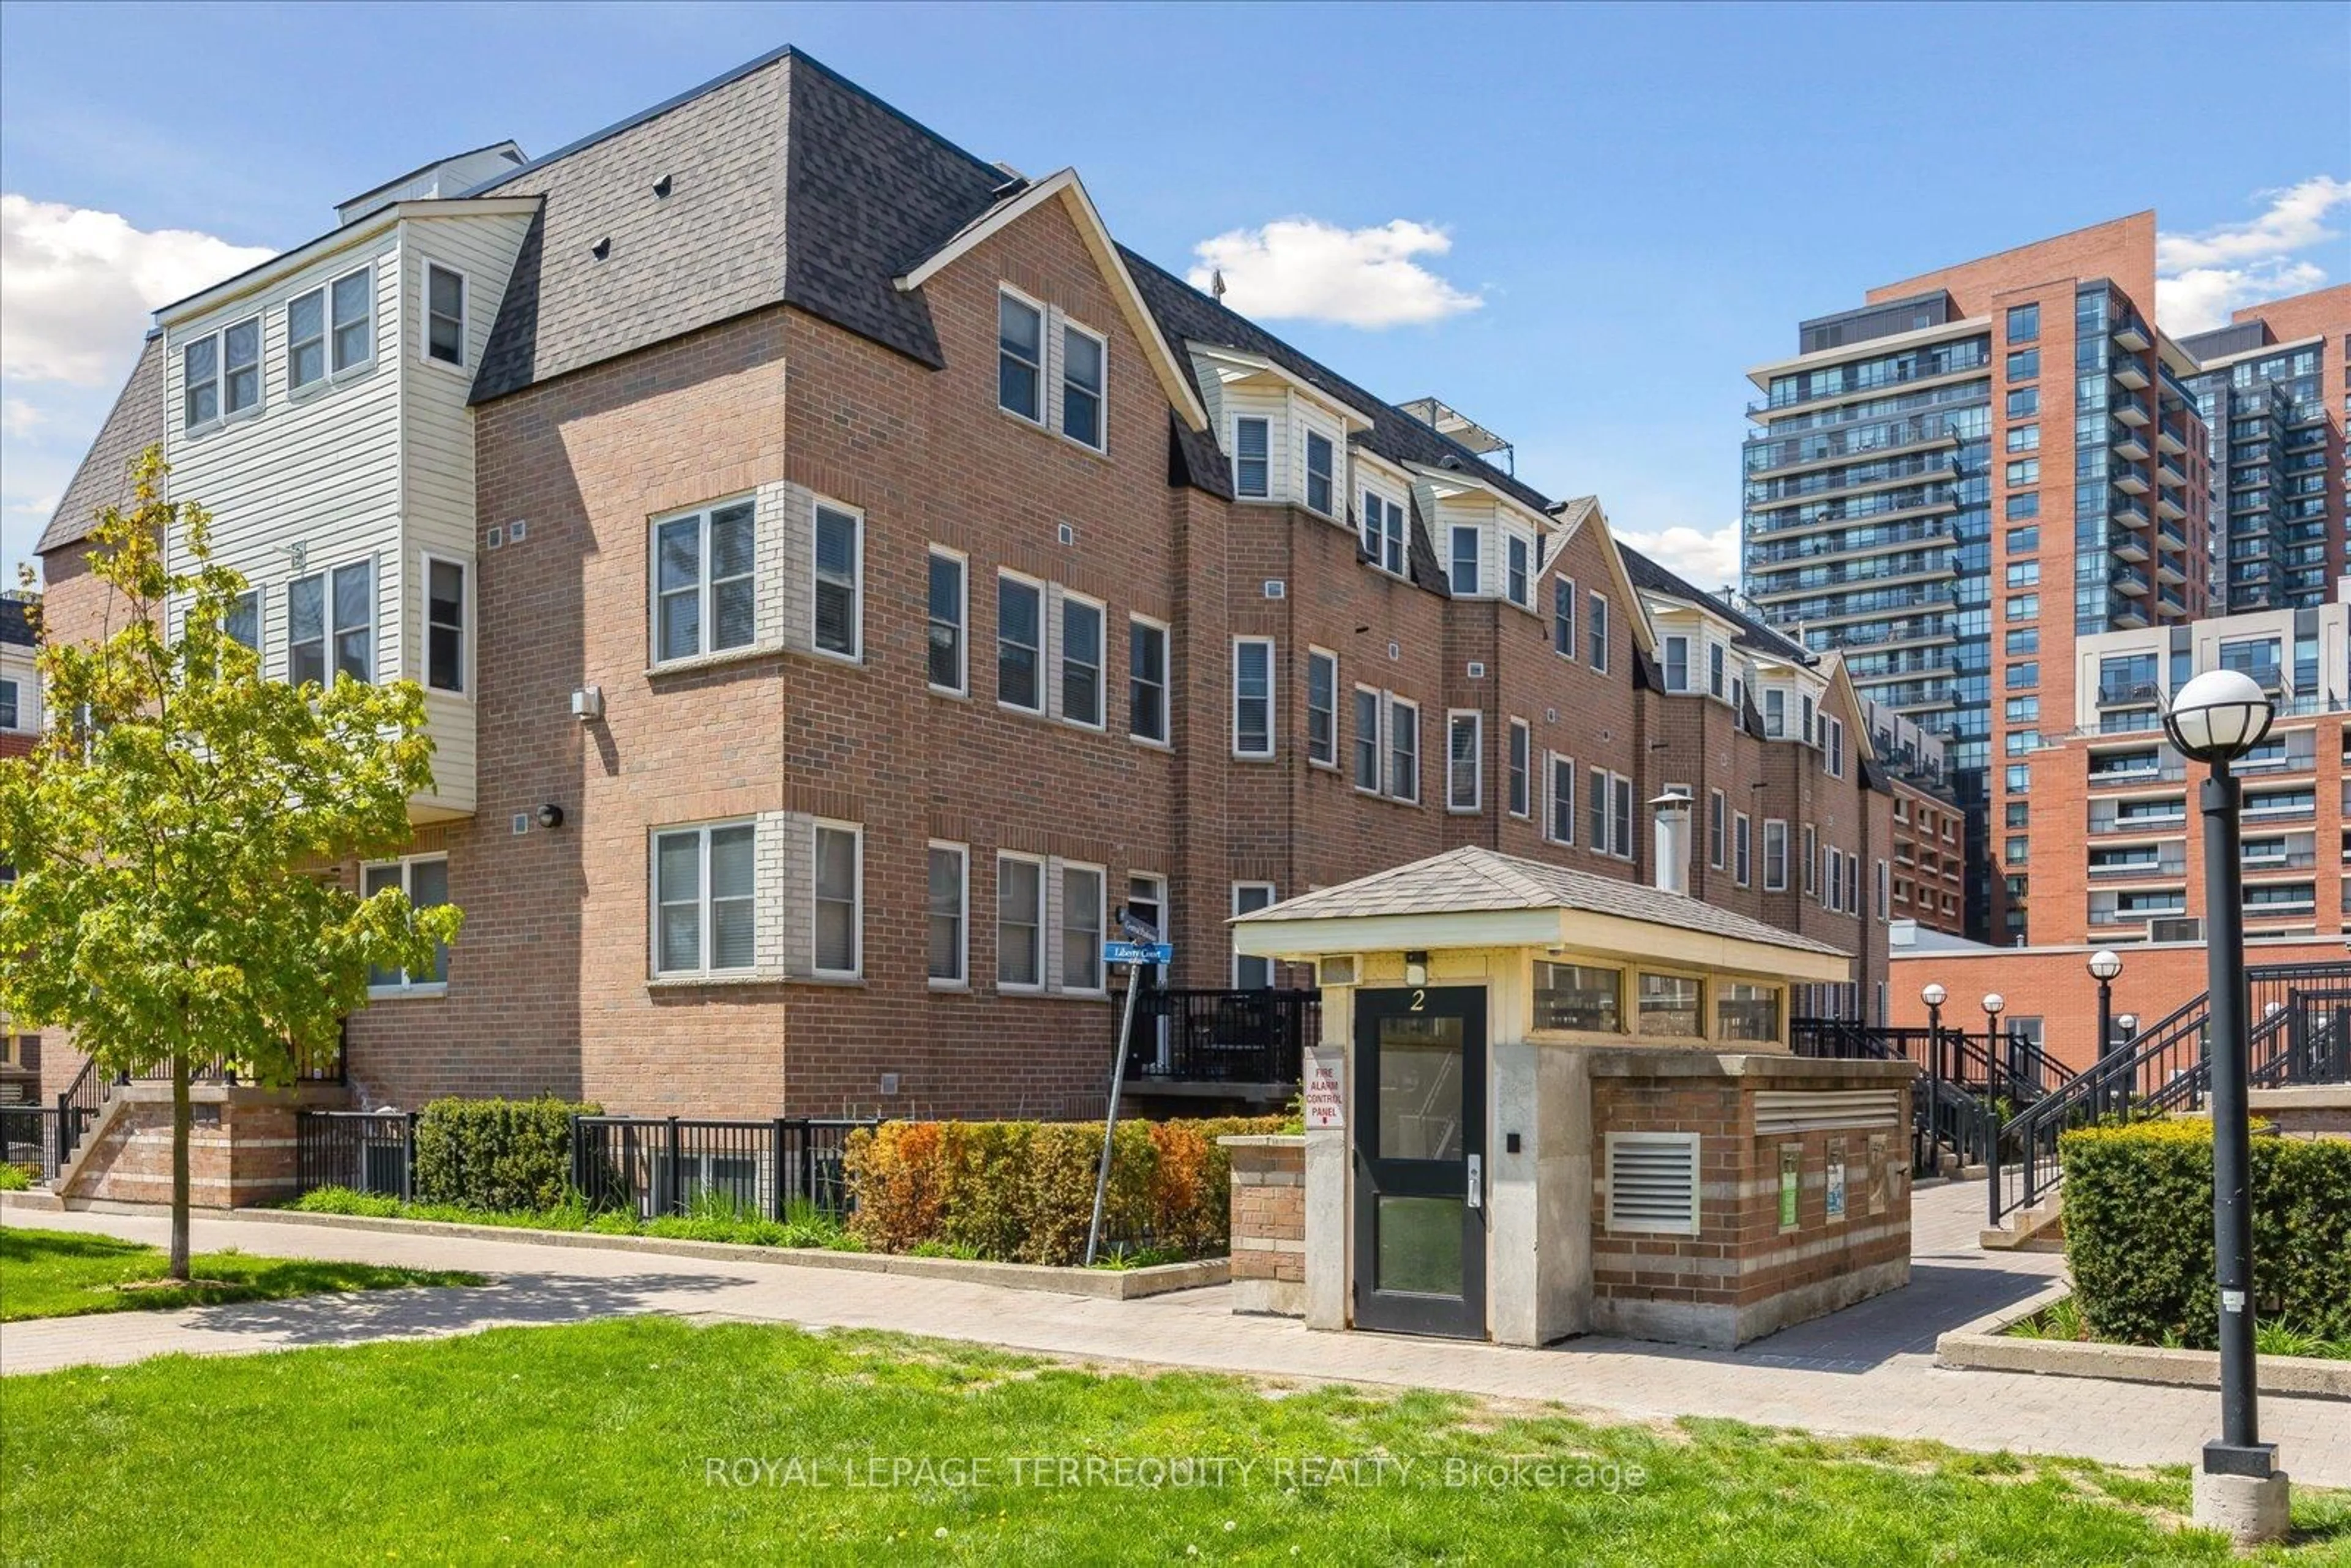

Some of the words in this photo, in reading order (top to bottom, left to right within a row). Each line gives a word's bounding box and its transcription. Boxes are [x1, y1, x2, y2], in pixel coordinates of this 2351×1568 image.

[1114, 947, 1139, 958] Liberty
[1141, 948, 1161, 958] Court
[1411, 989, 1425, 1011] 2
[1316, 1068, 1333, 1078] FIRE
[1311, 1081, 1338, 1090] ALARM
[1307, 1094, 1342, 1104] CONTROL
[1312, 1107, 1337, 1116] PANEL
